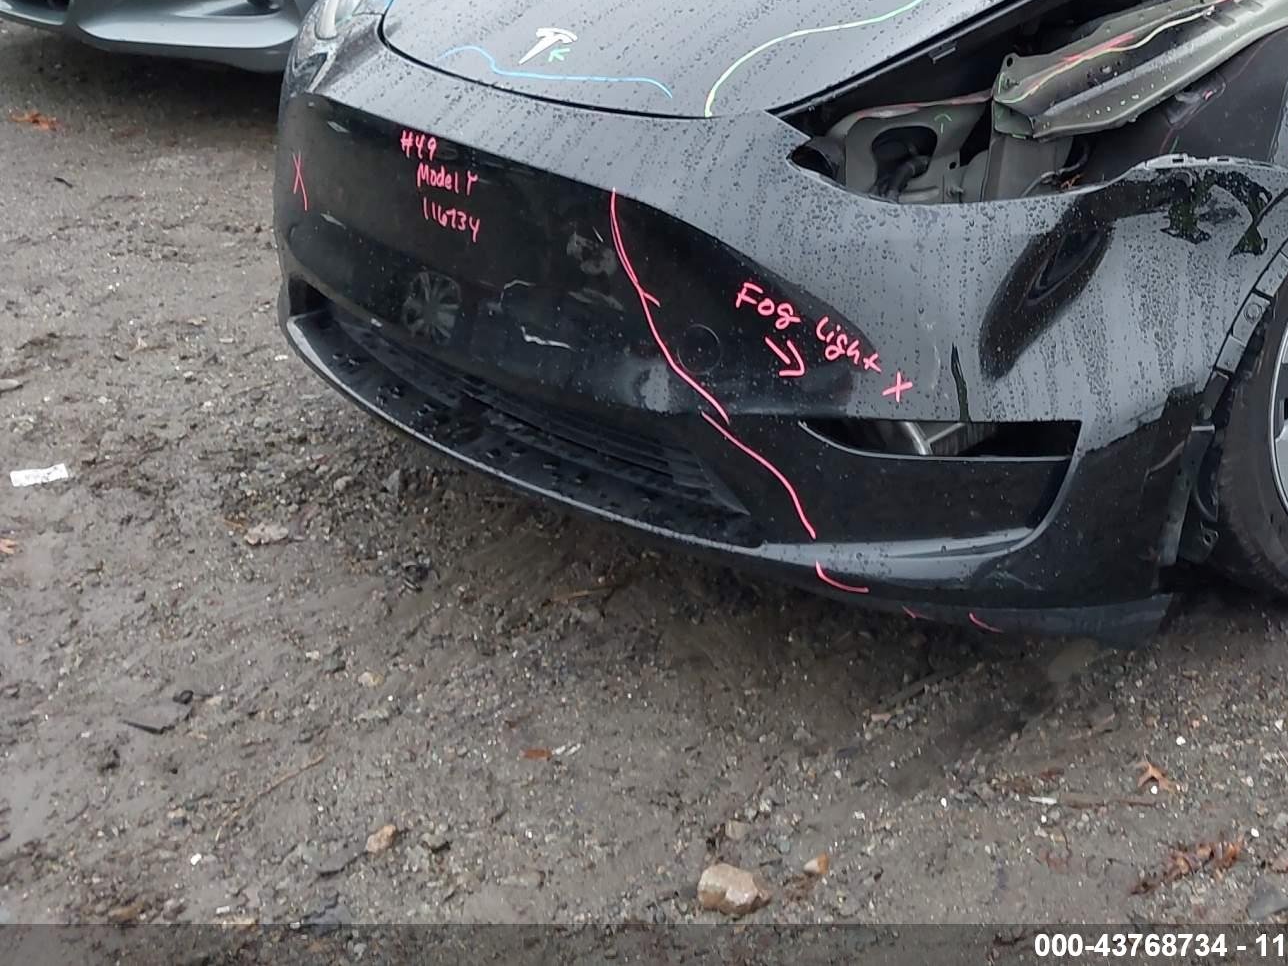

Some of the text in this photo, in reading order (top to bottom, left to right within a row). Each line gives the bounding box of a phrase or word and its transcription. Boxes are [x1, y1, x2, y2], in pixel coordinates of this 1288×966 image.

[400, 130, 437, 161] #49
[416, 162, 459, 194] Model
[423, 197, 481, 242] 116734
[735, 281, 802, 331] Fog
